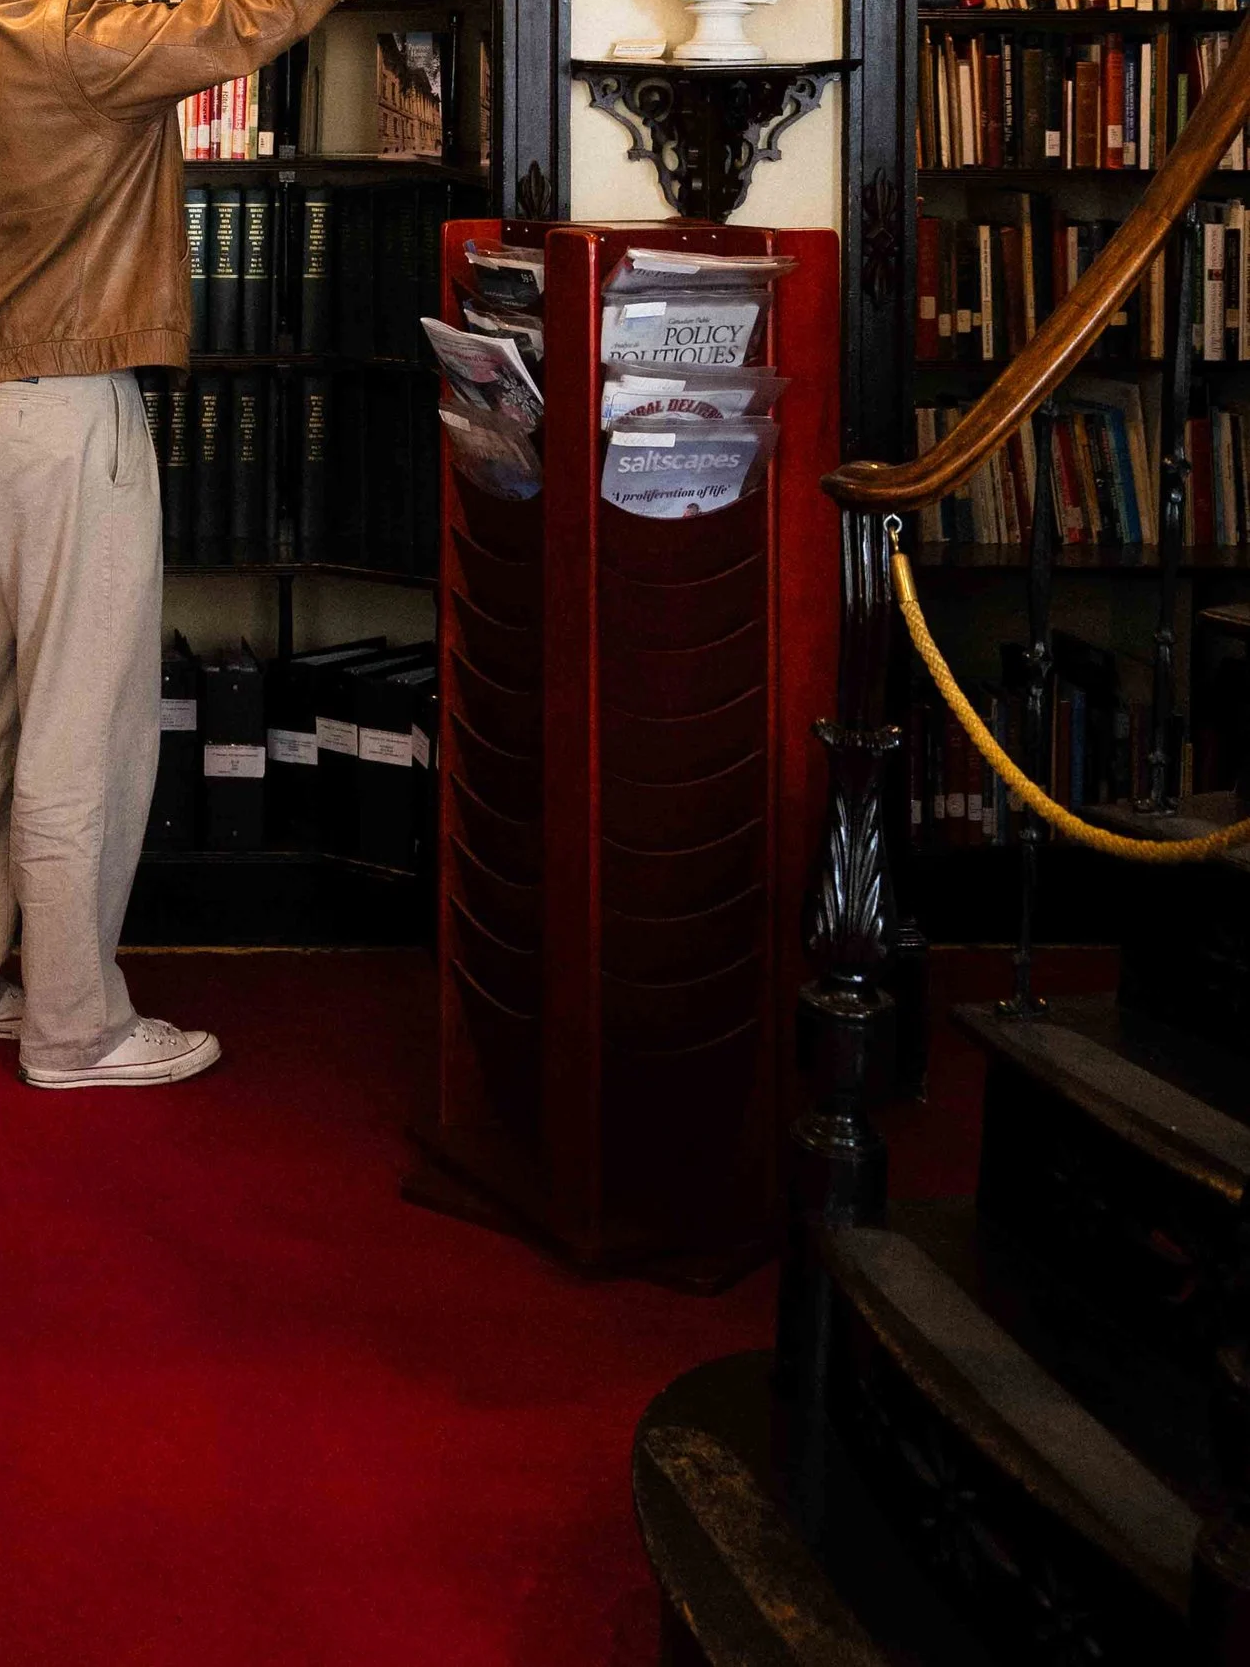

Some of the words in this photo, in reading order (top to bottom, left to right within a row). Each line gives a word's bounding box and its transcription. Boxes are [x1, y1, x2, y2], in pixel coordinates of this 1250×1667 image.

[236, 77, 244, 129] ORM-SIGNALS
[663, 324, 744, 346] POLICY
[618, 450, 740, 473] saltscapes
[622, 488, 696, 504] proliferation
[696, 486, 709, 498] of
